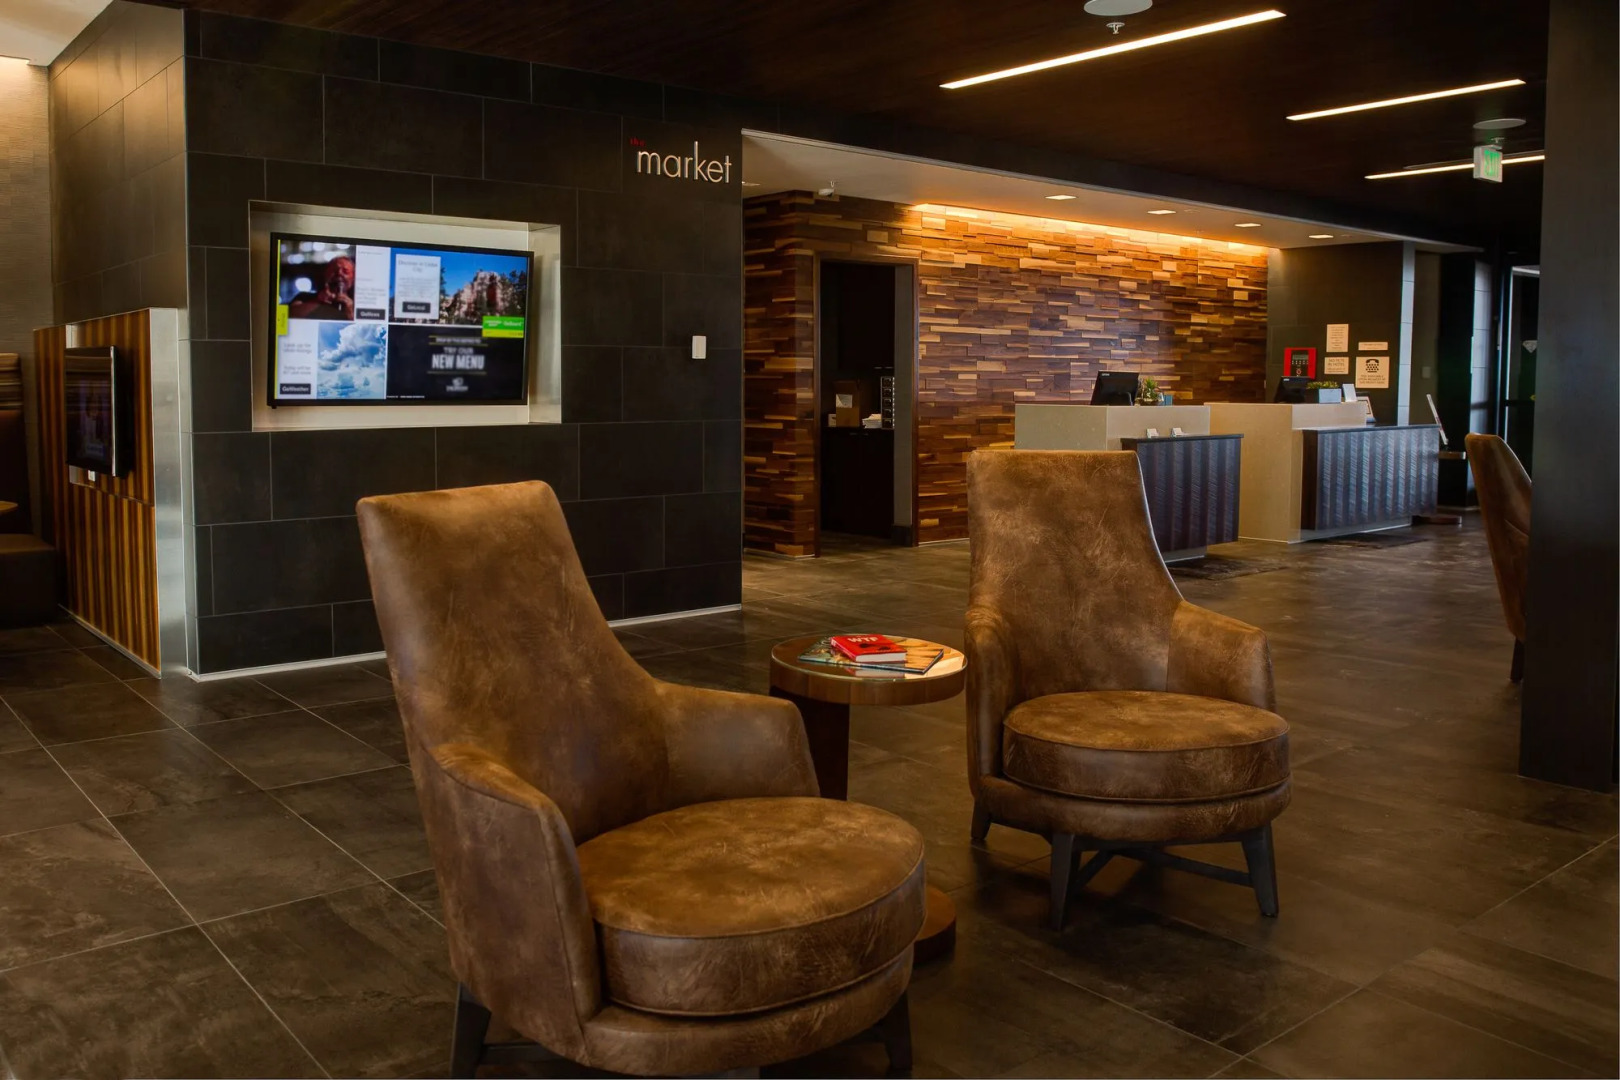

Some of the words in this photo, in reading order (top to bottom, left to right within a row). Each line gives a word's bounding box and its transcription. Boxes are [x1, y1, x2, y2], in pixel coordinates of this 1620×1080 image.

[630, 138, 645, 147] the
[637, 141, 732, 183] market
[431, 354, 455, 369] NEW
[455, 355, 485, 370] MENU
